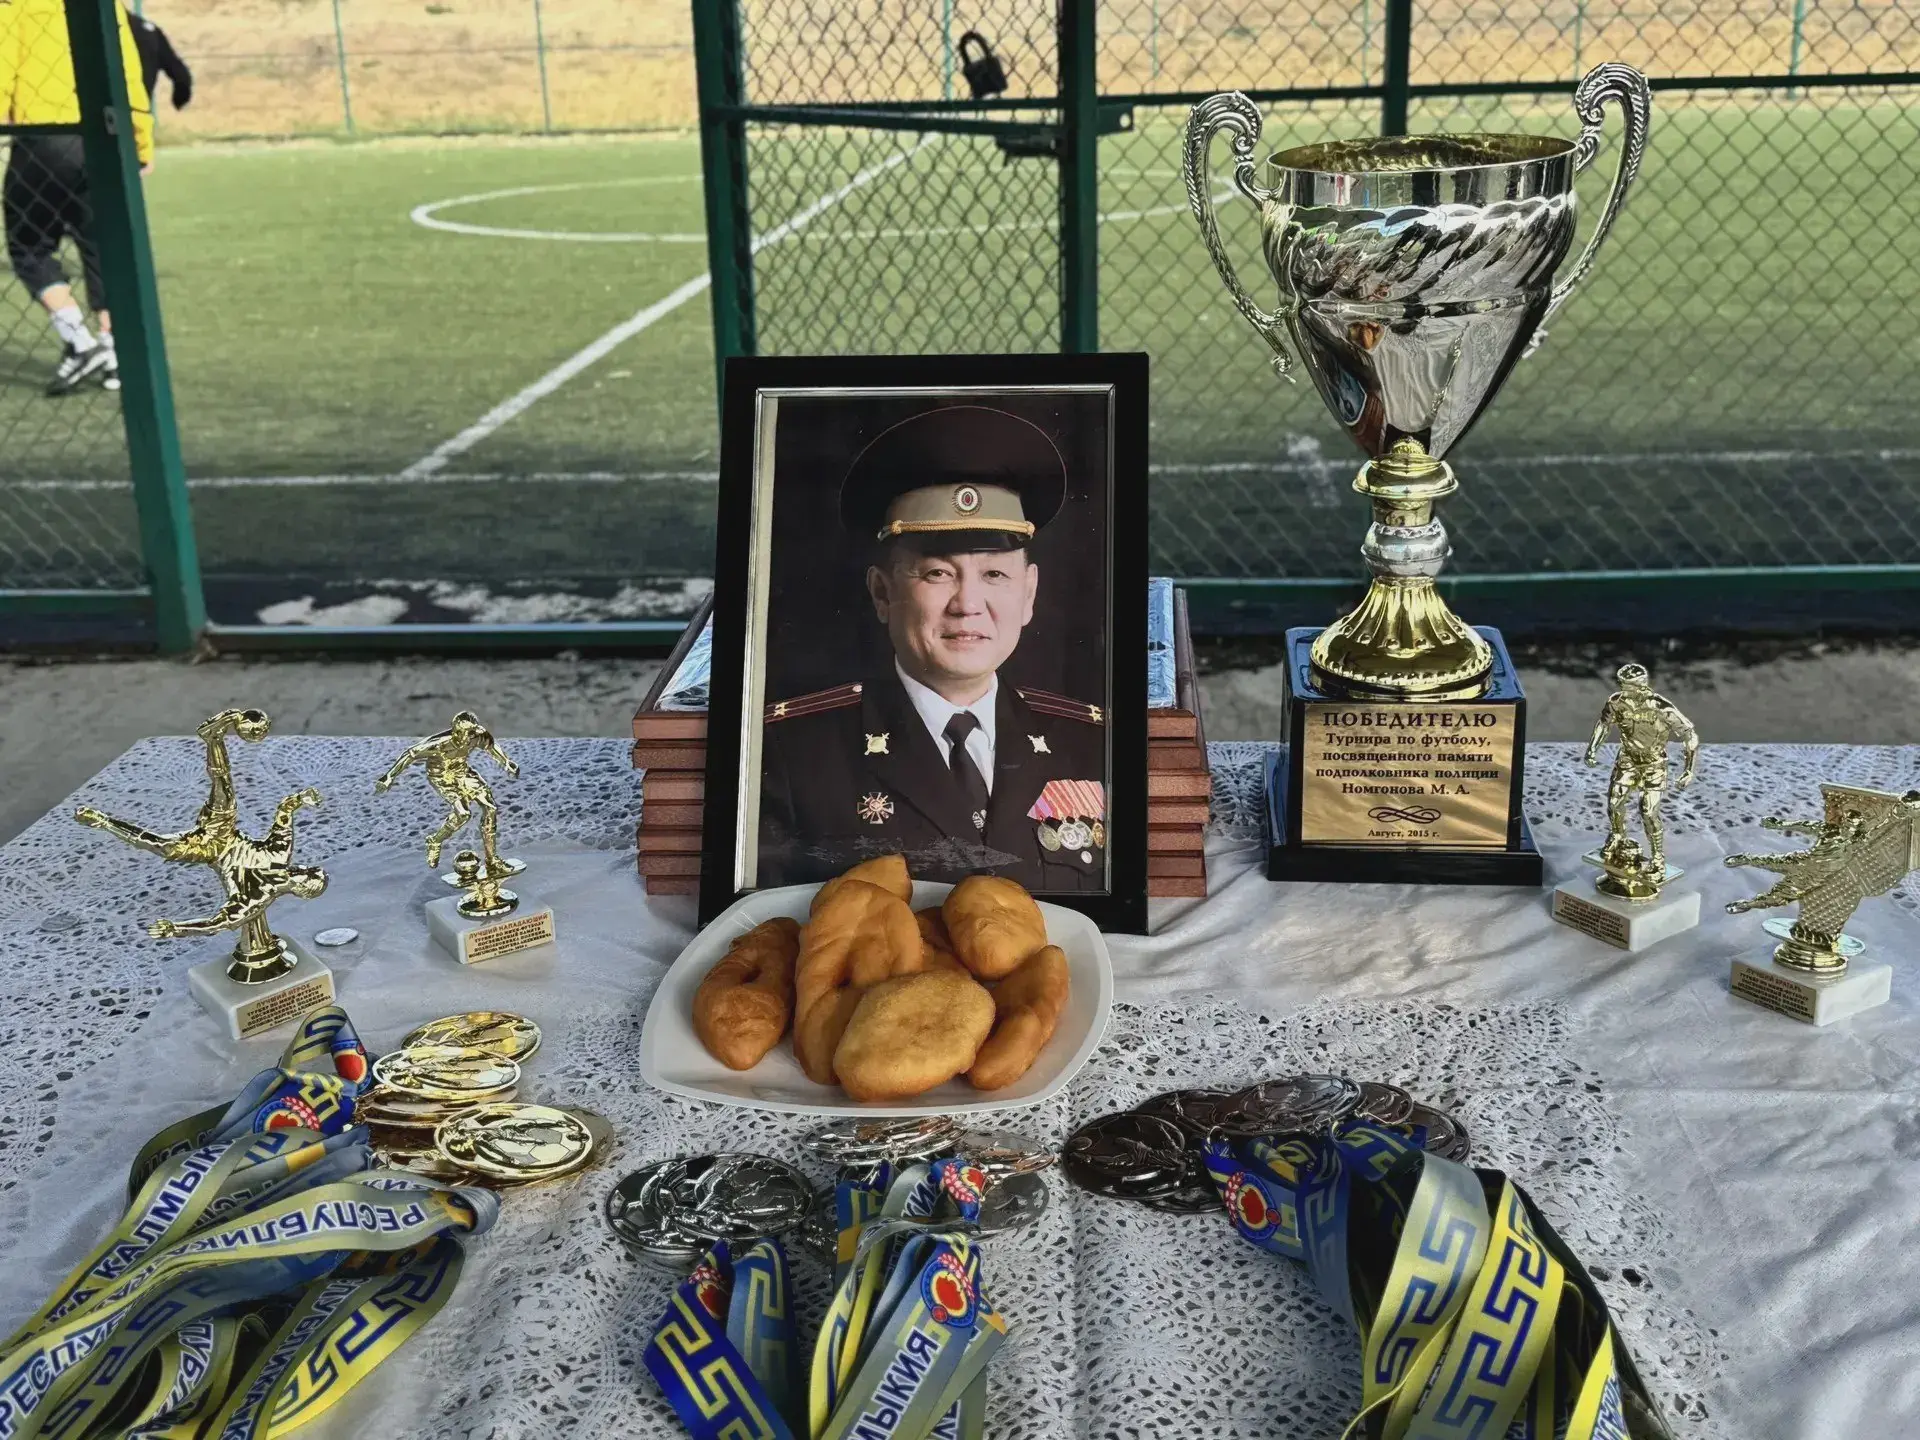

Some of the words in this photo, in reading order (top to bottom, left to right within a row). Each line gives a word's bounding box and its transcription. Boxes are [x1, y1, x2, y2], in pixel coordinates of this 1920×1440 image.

[1322, 711, 1498, 730] ПОБЕДИТЕЛЮ
[1325, 732, 1392, 747] Турнира
[1397, 734, 1416, 744] по
[1420, 732, 1492, 748] футболу,
[1322, 752, 1432, 764] посвященного
[1436, 752, 1493, 763] памяти
[1315, 767, 1429, 779] подполковника
[1434, 768, 1500, 780] полиции
[1341, 782, 1425, 795] Номгонова
[1430, 783, 1450, 795] М.
[1454, 783, 1471, 795] А.
[1367, 829, 1405, 839] Август,
[1407, 829, 1430, 838] 2015
